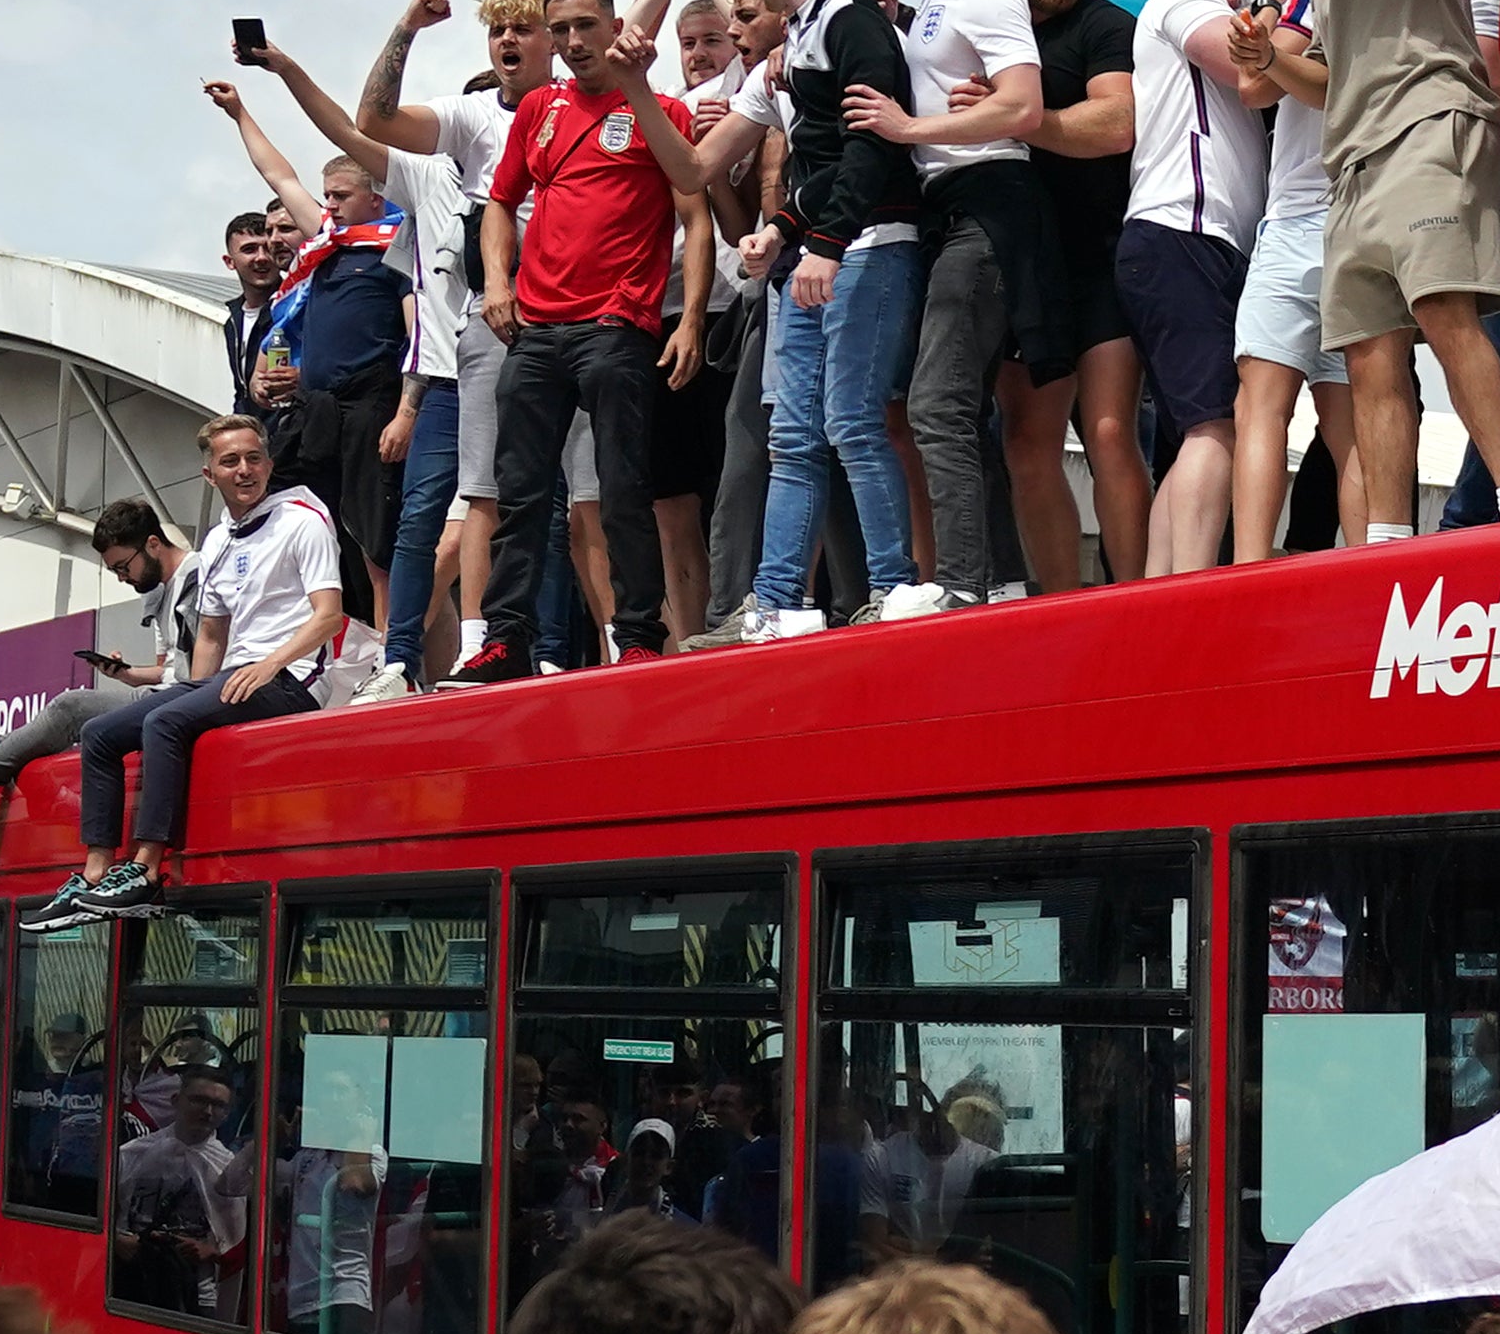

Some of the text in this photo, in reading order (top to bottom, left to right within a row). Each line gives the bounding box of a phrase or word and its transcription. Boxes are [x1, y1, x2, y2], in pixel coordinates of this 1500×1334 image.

[1409, 215, 1460, 232] ESSENTIALS
[922, 1036, 1046, 1048] WEMBLEY PARK THEATRE
